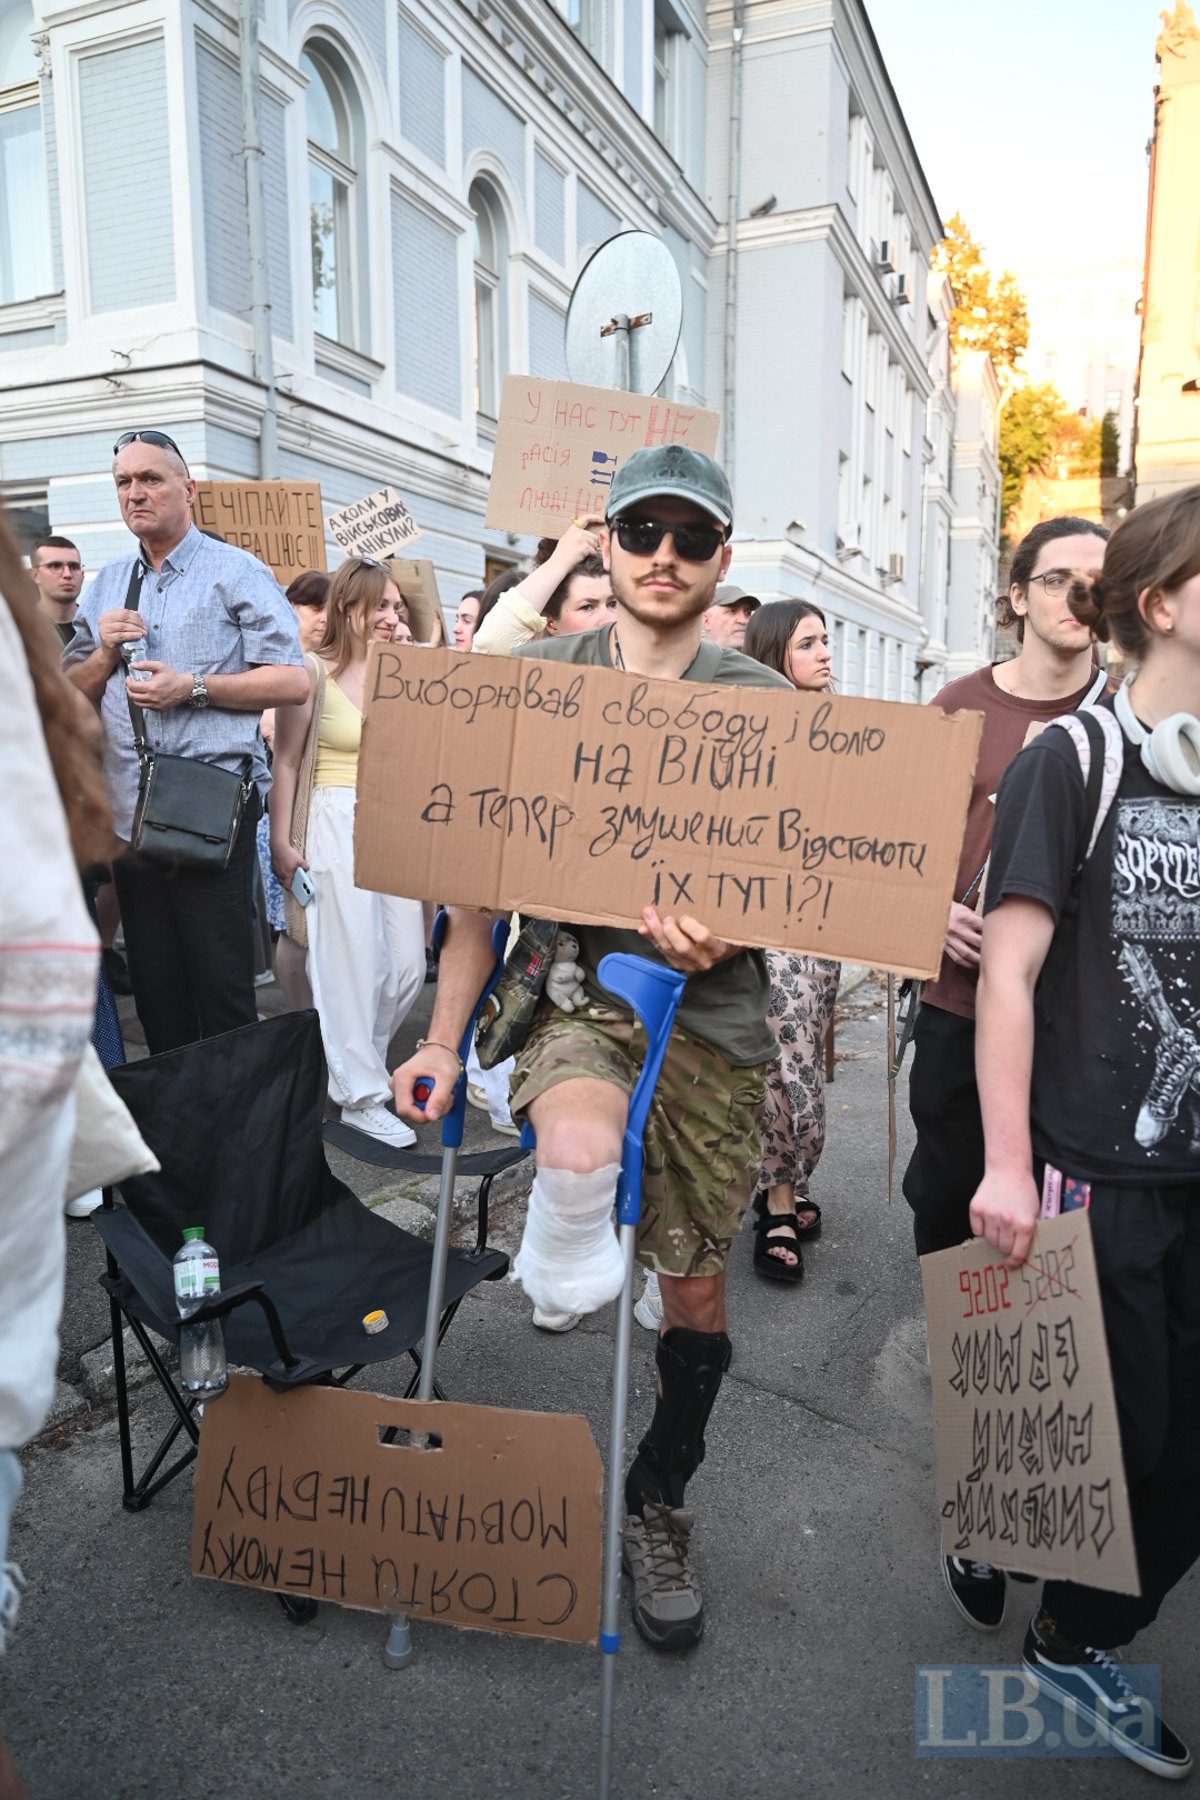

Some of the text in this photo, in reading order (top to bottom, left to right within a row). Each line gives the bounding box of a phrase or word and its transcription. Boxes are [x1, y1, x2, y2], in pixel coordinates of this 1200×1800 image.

[523, 391, 542, 424] У
[554, 400, 598, 429] НАС
[607, 410, 642, 434] ТУТ
[328, 489, 389, 531] А КОЛИ У
[371, 652, 585, 725] Виборював
[602, 690, 769, 763] свободу
[808, 700, 886, 757] волю
[588, 803, 771, 861] змушений
[959, 1264, 1012, 1318] 2026
[966, 1400, 1093, 1482] НОВИЙ
[381, 1485, 568, 1550] МОВЧАТИ
[371, 1554, 579, 1627] СТОЯТИ
